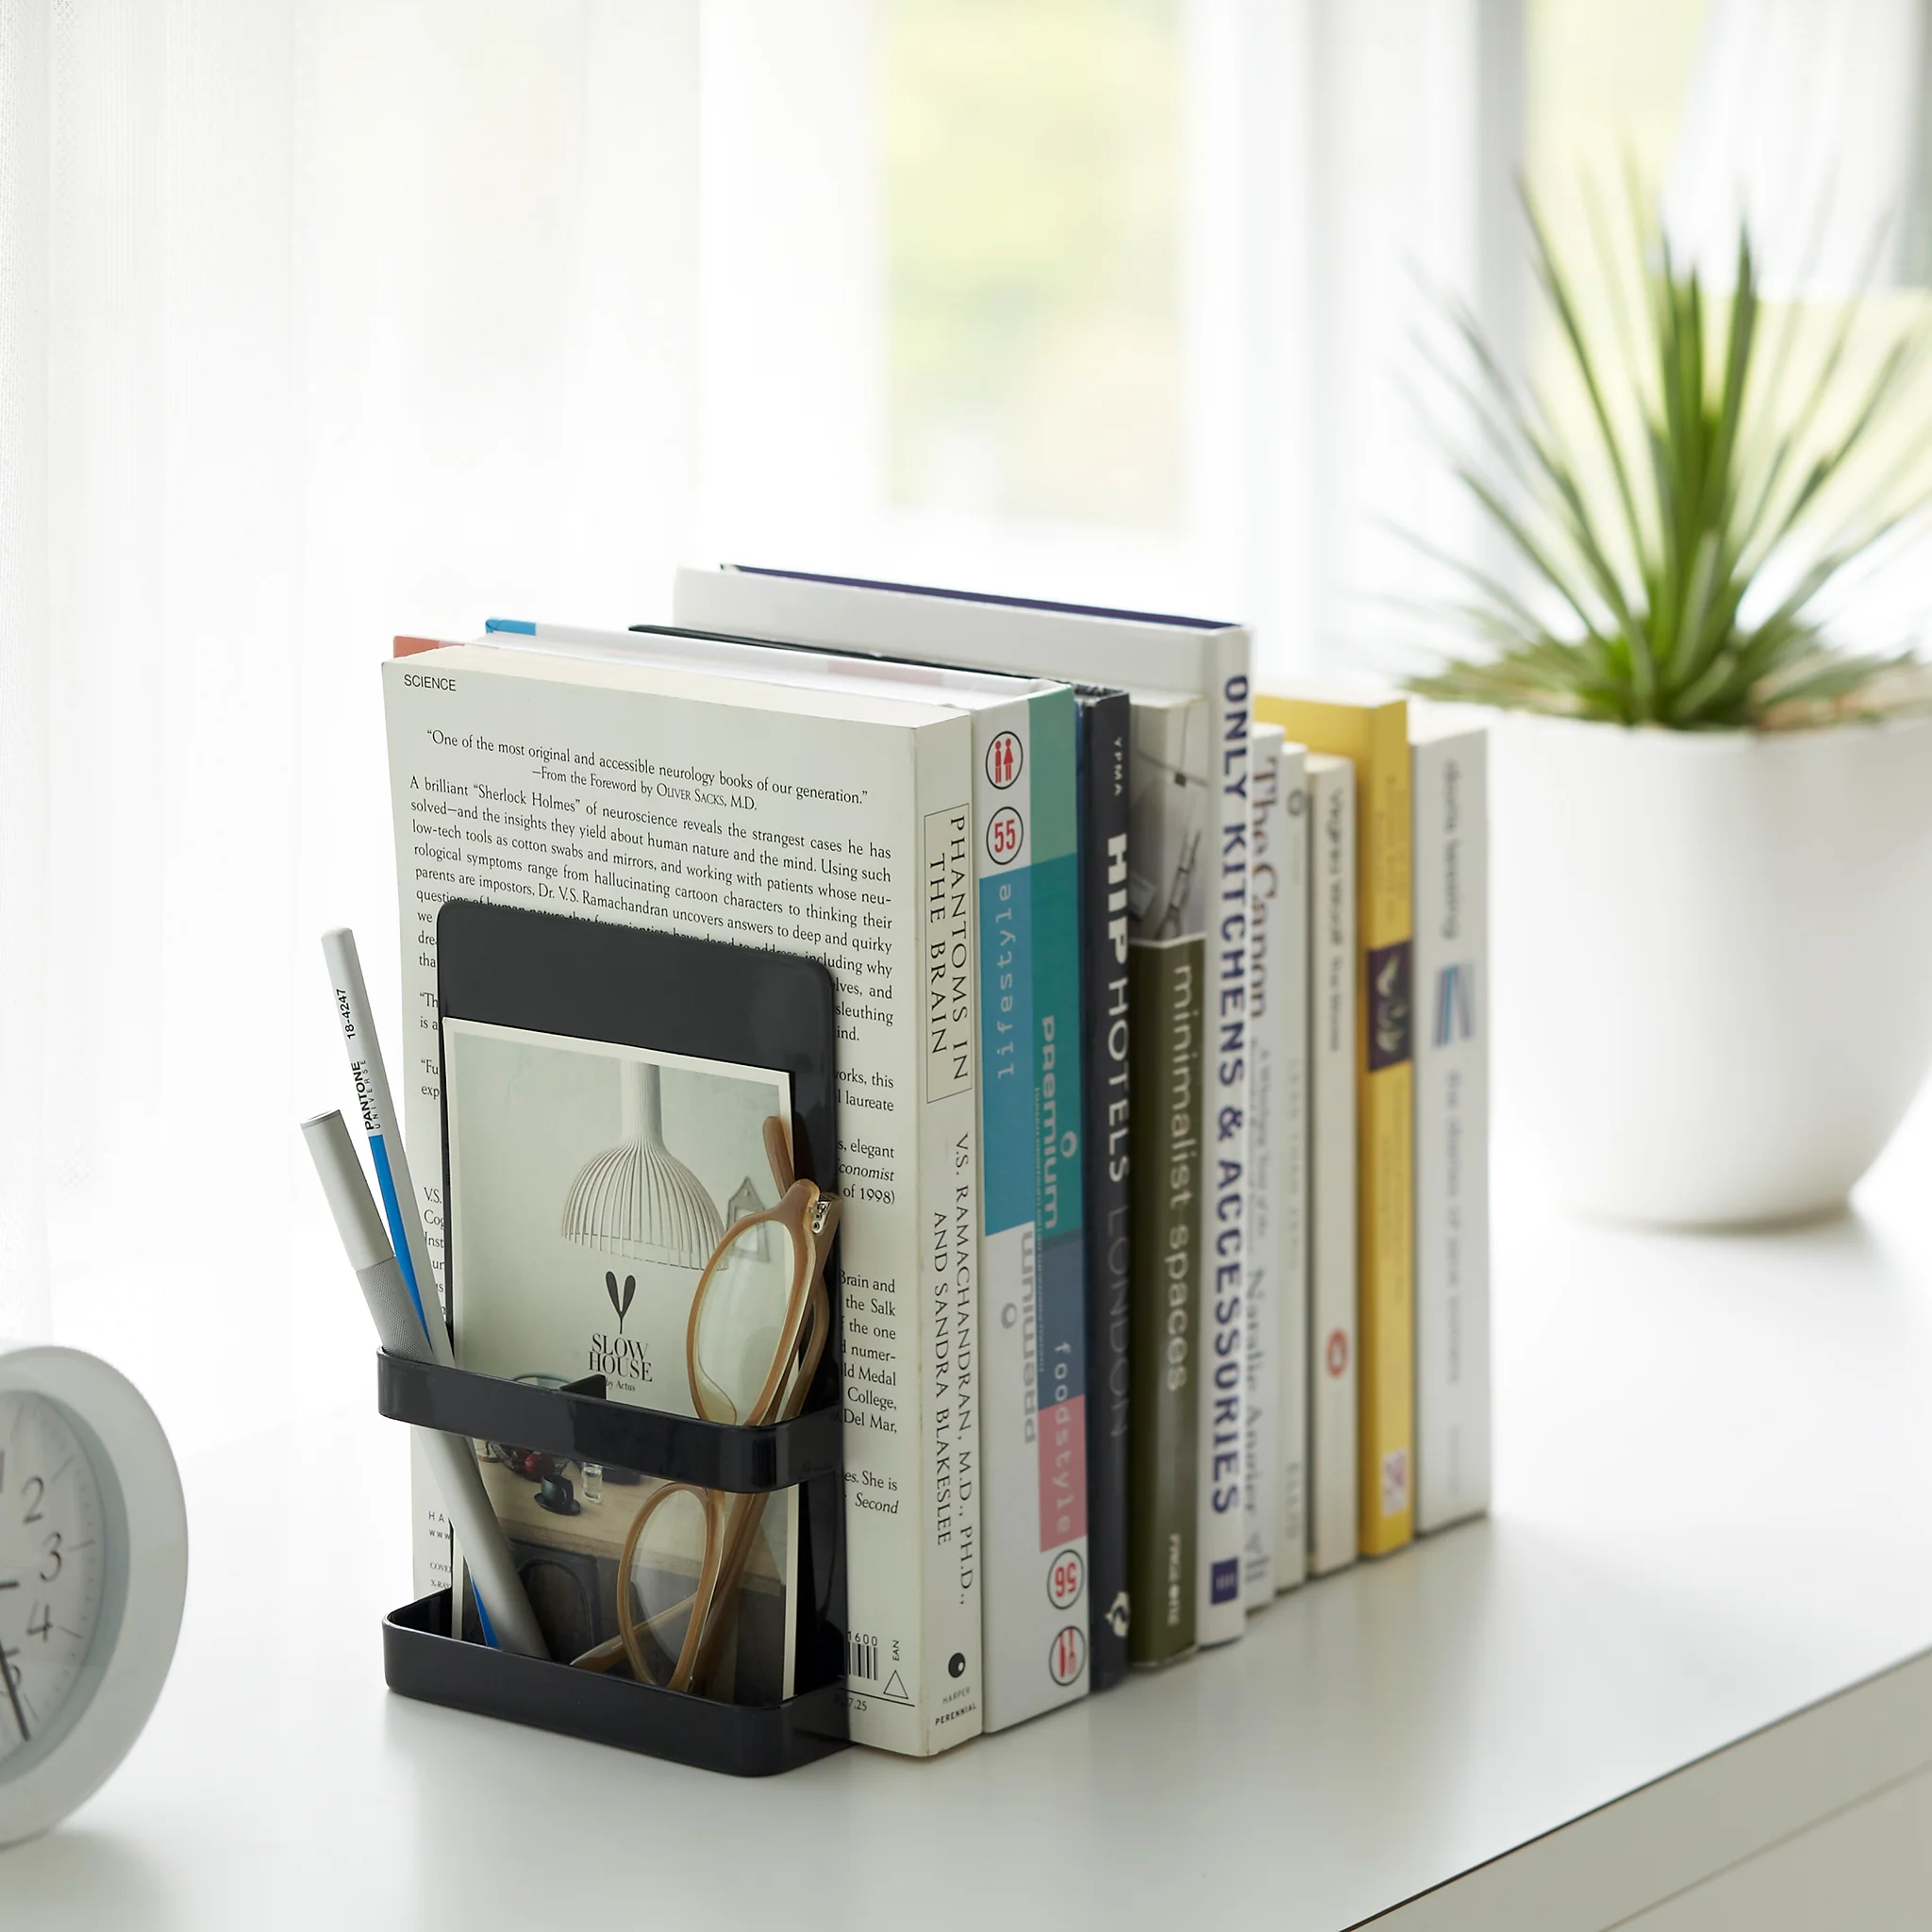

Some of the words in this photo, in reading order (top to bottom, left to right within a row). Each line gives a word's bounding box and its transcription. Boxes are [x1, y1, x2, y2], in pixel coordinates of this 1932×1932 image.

[404, 674, 457, 691] SCIENCE
[461, 734, 474, 748] of
[476, 735, 494, 752] the
[498, 743, 525, 757] most
[528, 745, 570, 763] original
[574, 751, 595, 766] and
[599, 758, 656, 774] accessible
[658, 766, 715, 787] neurology
[719, 770, 753, 790] books
[757, 776, 769, 791] of
[772, 783, 792, 794] our
[1224, 675, 1249, 801] ONLY
[409, 774, 420, 790] A
[424, 776, 469, 796] brilliant
[586, 801, 598, 816] of
[602, 808, 678, 828] neuroscience
[683, 819, 723, 835] reveals
[727, 822, 747, 839] the
[752, 830, 805, 849] strangest
[809, 839, 842, 853] cases
[848, 839, 863, 856] he
[870, 841, 891, 859] has
[570, 770, 587, 786] the
[590, 773, 637, 793] Foreword
[640, 780, 654, 798] by
[656, 782, 691, 801] OLIVER
[694, 788, 727, 808] SACKS,
[730, 794, 758, 811] M.D.
[1251, 756, 1279, 858] The
[412, 818, 461, 840] low-tech
[465, 829, 492, 844] tools
[496, 836, 508, 847] as
[511, 839, 547, 853] cotton
[551, 842, 584, 859] swabs
[587, 848, 608, 863] and
[613, 853, 657, 872] mirrors,
[660, 859, 682, 874] and
[686, 864, 733, 887] working
[736, 872, 762, 887] with
[767, 878, 814, 895] patients
[817, 882, 857, 902] whose
[861, 892, 891, 906] neu-
[482, 807, 501, 824] the
[504, 811, 547, 832] insights
[551, 817, 575, 838] they
[579, 824, 607, 840] yield
[610, 827, 643, 845] about
[647, 831, 689, 853] human
[692, 844, 729, 859] nature
[733, 848, 756, 863] and
[759, 850, 779, 867] the
[783, 857, 817, 872] mind.
[821, 858, 858, 882] Using
[861, 867, 891, 883] such
[993, 819, 1016, 853] 55
[414, 842, 461, 862] rological
[466, 854, 523, 872] symptoms
[527, 863, 558, 880] range
[563, 863, 589, 882] from
[594, 869, 671, 899] hallucinating
[675, 887, 718, 903] cartoon
[723, 891, 783, 914] characters
[789, 904, 801, 916] to
[806, 903, 858, 929] thinking
[863, 911, 892, 929] their
[415, 868, 456, 883] parents
[458, 874, 475, 886] are
[478, 874, 535, 896] impostors,
[538, 882, 555, 899] Dr.
[558, 885, 579, 903] V.S.
[582, 890, 669, 918] Ramachandran
[672, 909, 724, 927] uncovers
[726, 919, 774, 935] answers
[777, 925, 790, 938] to
[792, 924, 822, 945] deep
[824, 931, 848, 947] and
[851, 936, 892, 956] quirky
[930, 853, 946, 924] THE
[1108, 833, 1128, 964] HIP
[950, 815, 968, 1023] PHANTOMS
[1250, 862, 1278, 1021] Canon
[417, 912, 433, 923] we
[833, 977, 863, 997] lves,
[869, 985, 892, 1000] and
[866, 959, 892, 979] why
[995, 883, 1016, 1079] lifestyle
[1218, 824, 1247, 1088] KITCHENS
[336, 989, 356, 1040] 18-4247
[835, 1001, 893, 1026] sleuthing
[930, 941, 947, 1054] BRAIN
[872, 1072, 894, 1089] this
[953, 1040, 969, 1080] IN
[1108, 977, 1129, 1183] HOTELS
[1170, 964, 1199, 1210] minimalist
[351, 1061, 375, 1130] PANTONE
[359, 1059, 381, 1130] UNIVERSE
[845, 1090, 894, 1111] laureate
[1217, 1106, 1242, 1141] &
[839, 1160, 895, 1181] conomist
[850, 1139, 894, 1158] elegant
[956, 1132, 969, 1175] V.S.
[842, 1184, 857, 1197] of
[859, 1188, 895, 1205] 1998)
[424, 1187, 442, 1204] V.S.
[873, 1279, 895, 1293] and
[934, 1212, 949, 1273] AND
[846, 1294, 865, 1310] the
[871, 1298, 896, 1316] Salk
[849, 1318, 868, 1335] the
[873, 1326, 896, 1340] one
[956, 1185, 973, 1441] RAMACHANDRAN,
[1108, 1206, 1129, 1437] LONDON
[1164, 1224, 1191, 1392] spaces
[589, 1351, 653, 1382] HOUSE
[591, 1333, 649, 1360] SLOW
[851, 1345, 896, 1361] numer-
[934, 1283, 949, 1398] SANDRA
[1211, 1158, 1242, 1516] ACCESSORIES
[847, 1386, 897, 1410] College,
[858, 1366, 896, 1386] Medal
[843, 1409, 865, 1426] Del
[870, 1414, 898, 1434] Mar,
[1053, 1341, 1074, 1533] foodstyle
[21, 1474, 45, 1524] 2
[855, 1492, 899, 1514] Second
[862, 1470, 885, 1489] She
[888, 1477, 898, 1491] is
[936, 1407, 952, 1546] BLAKESLEE
[958, 1451, 973, 1517] M.D.,
[39, 1531, 62, 1582] 3
[960, 1525, 974, 1605] PH.D.,
[26, 1599, 54, 1643] 4
